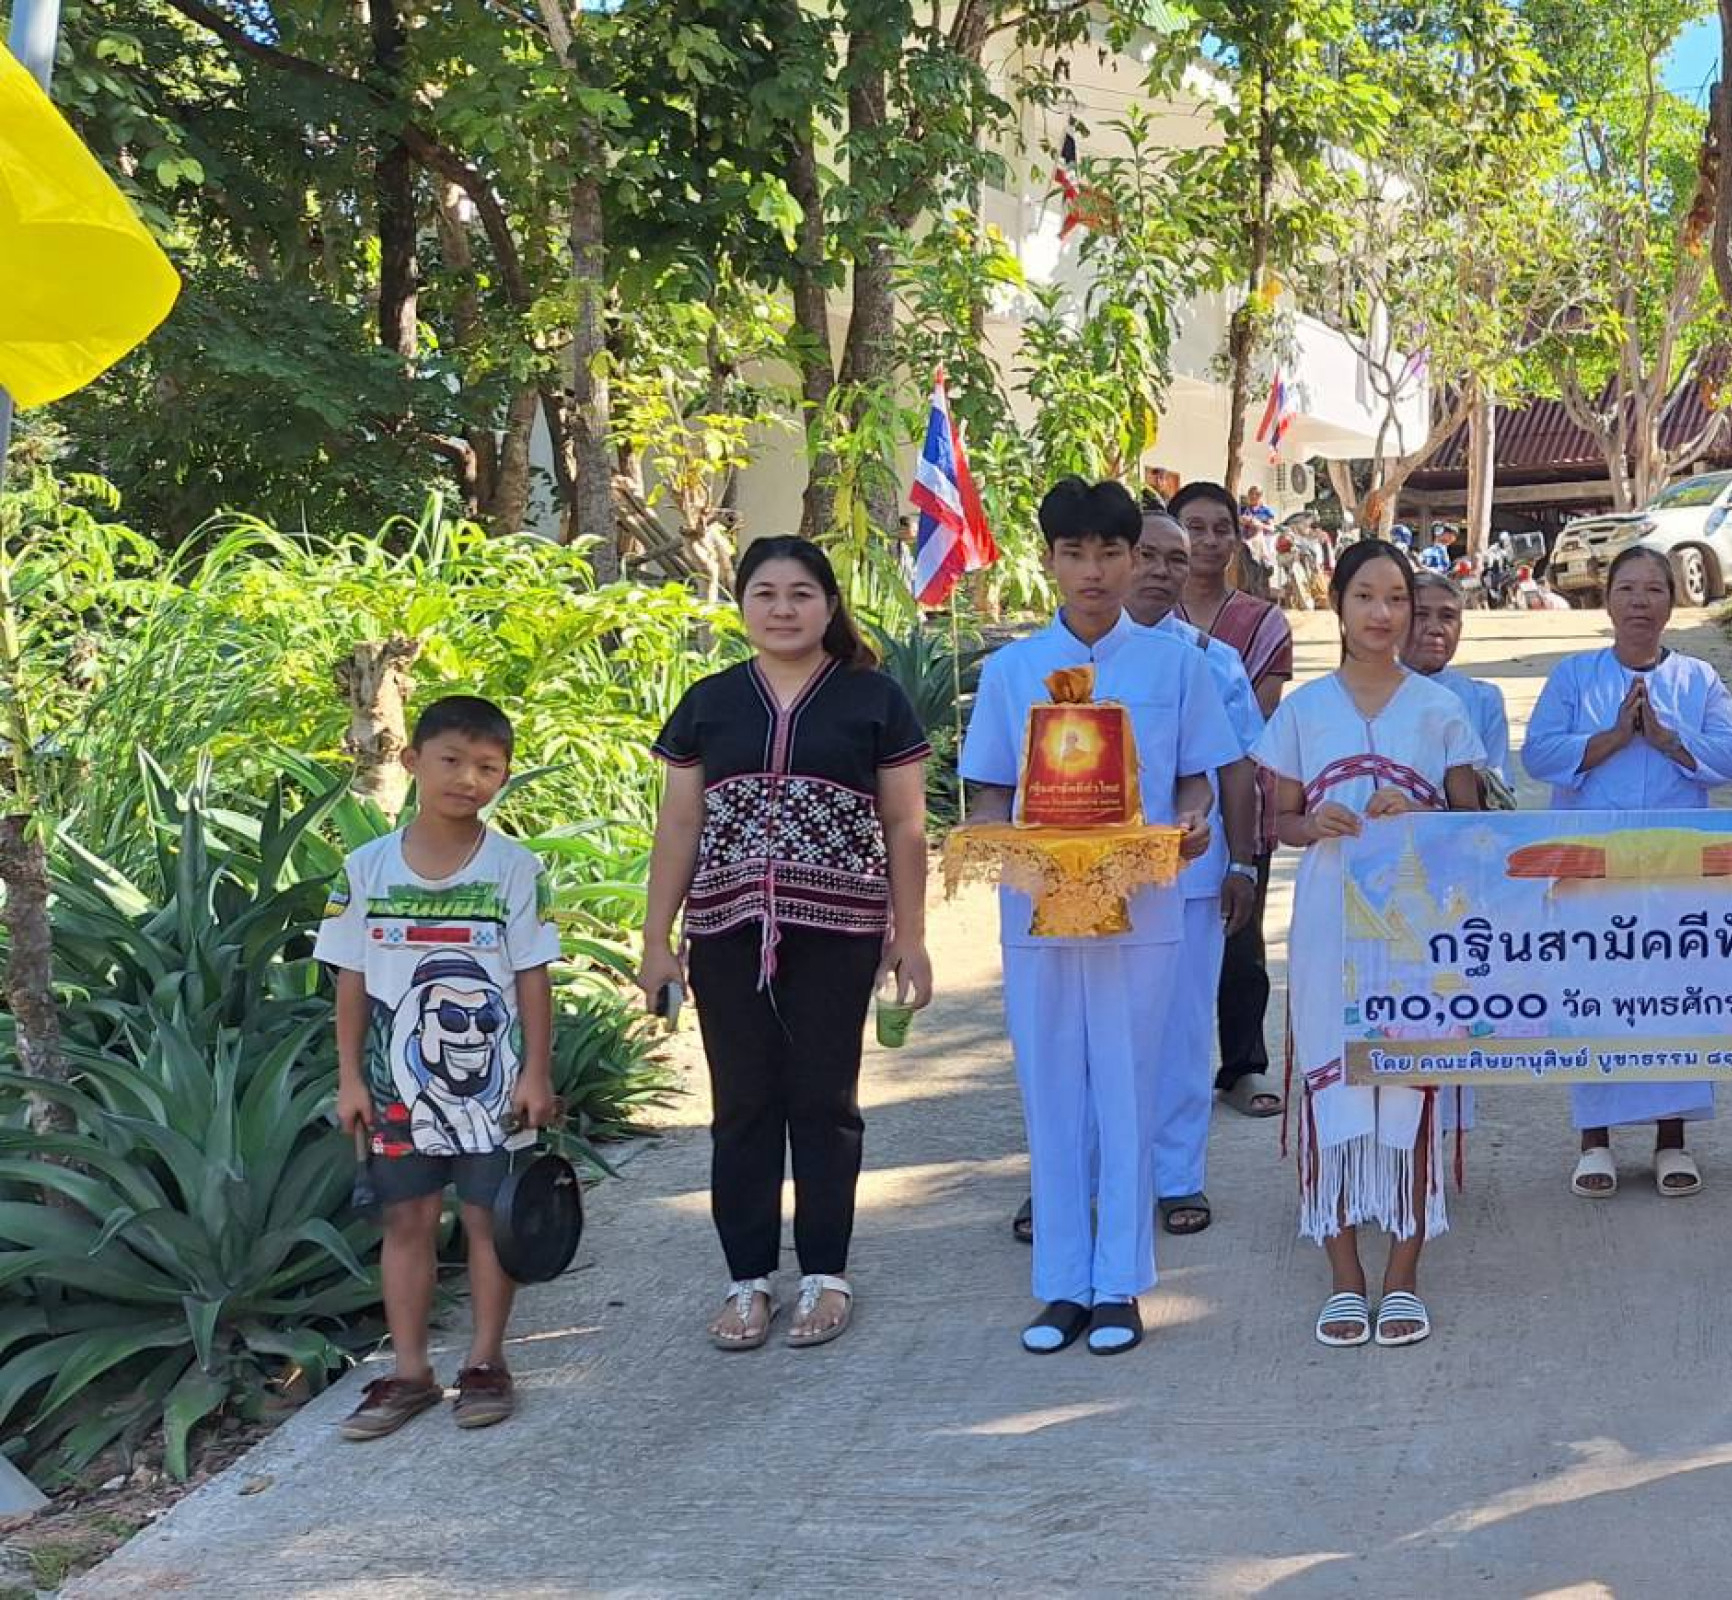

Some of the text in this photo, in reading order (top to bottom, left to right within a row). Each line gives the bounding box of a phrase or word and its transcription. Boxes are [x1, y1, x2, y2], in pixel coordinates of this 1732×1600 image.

[1365, 994, 1548, 1026] ๓๐,๐๐๐
[1562, 988, 1601, 1018] วัด
[1371, 1051, 1412, 1071] โดย
[1420, 1047, 1589, 1076] คณะศิษยานุศิษย์
[1597, 1049, 1698, 1073] บูชาธรรม
